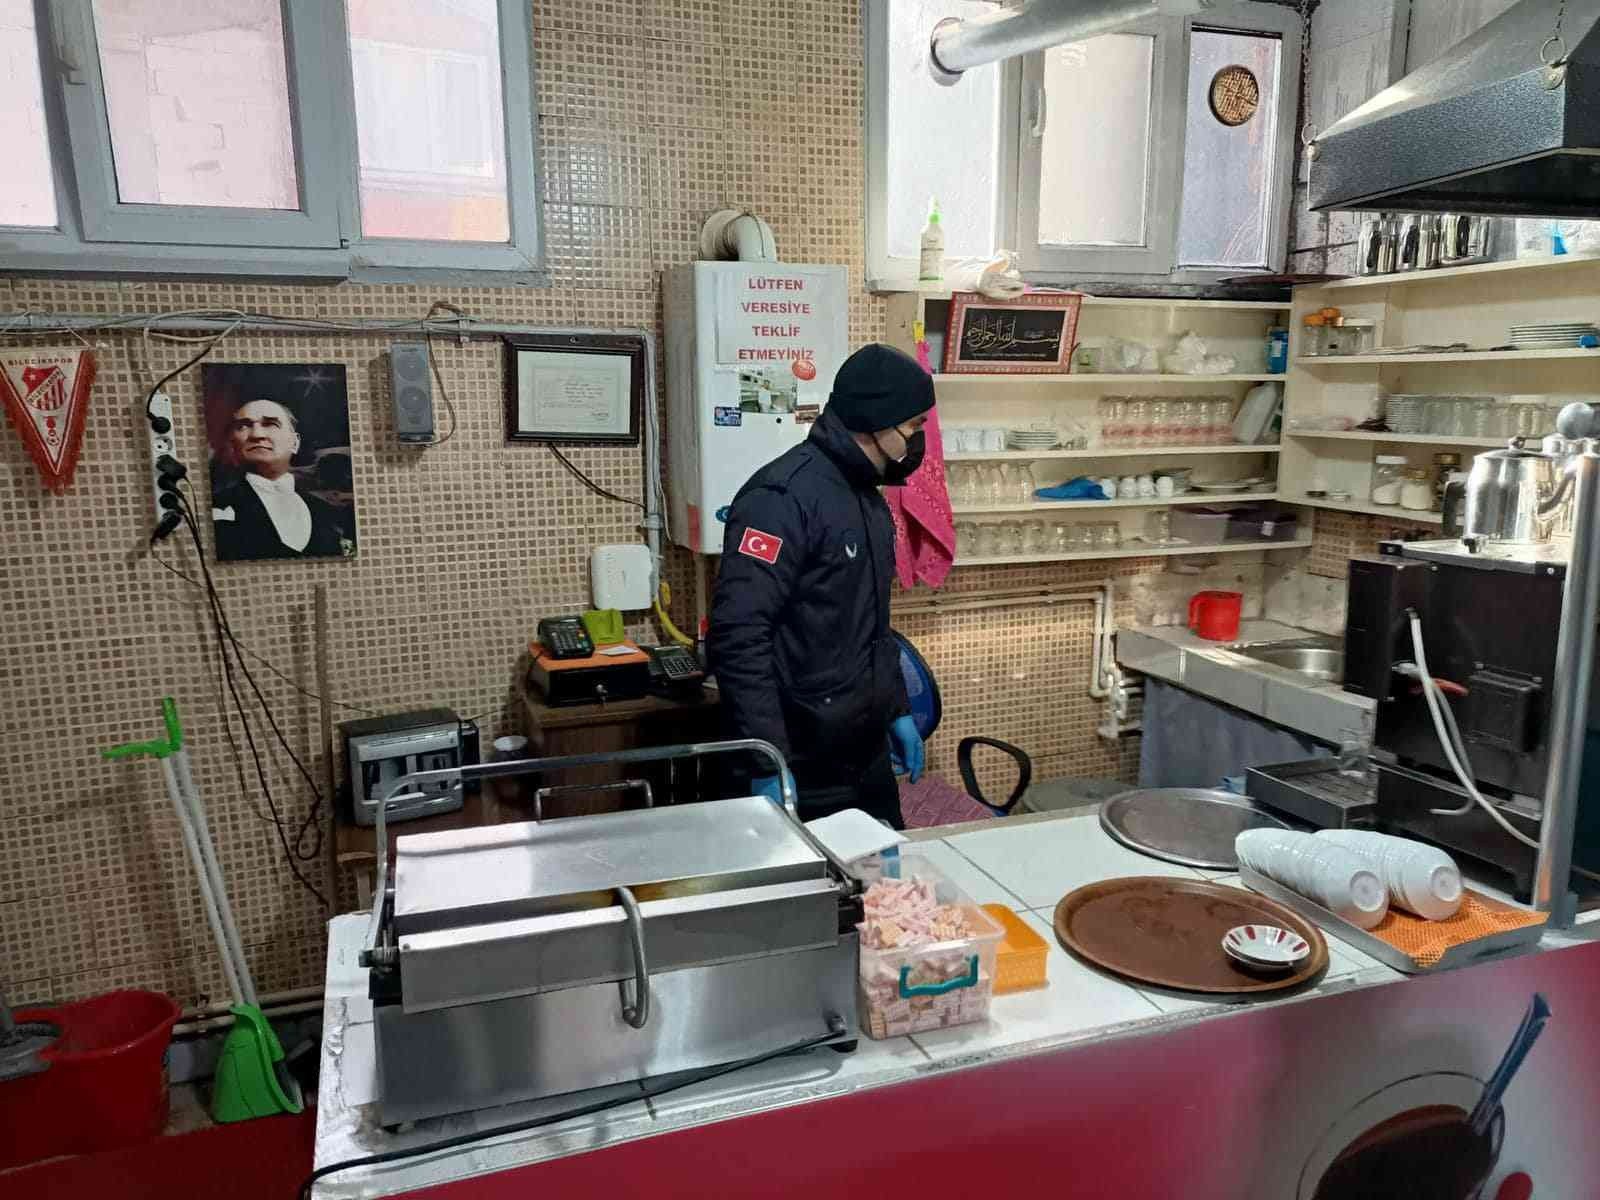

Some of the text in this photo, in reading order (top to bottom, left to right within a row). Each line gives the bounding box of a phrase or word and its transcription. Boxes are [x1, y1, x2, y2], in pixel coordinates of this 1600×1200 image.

[748, 276, 803, 290] LÜTFEN
[740, 300, 810, 314] VERESİYE
[751, 324, 801, 337] TEKLİF
[738, 347, 815, 361] ETMEYİNİZ
